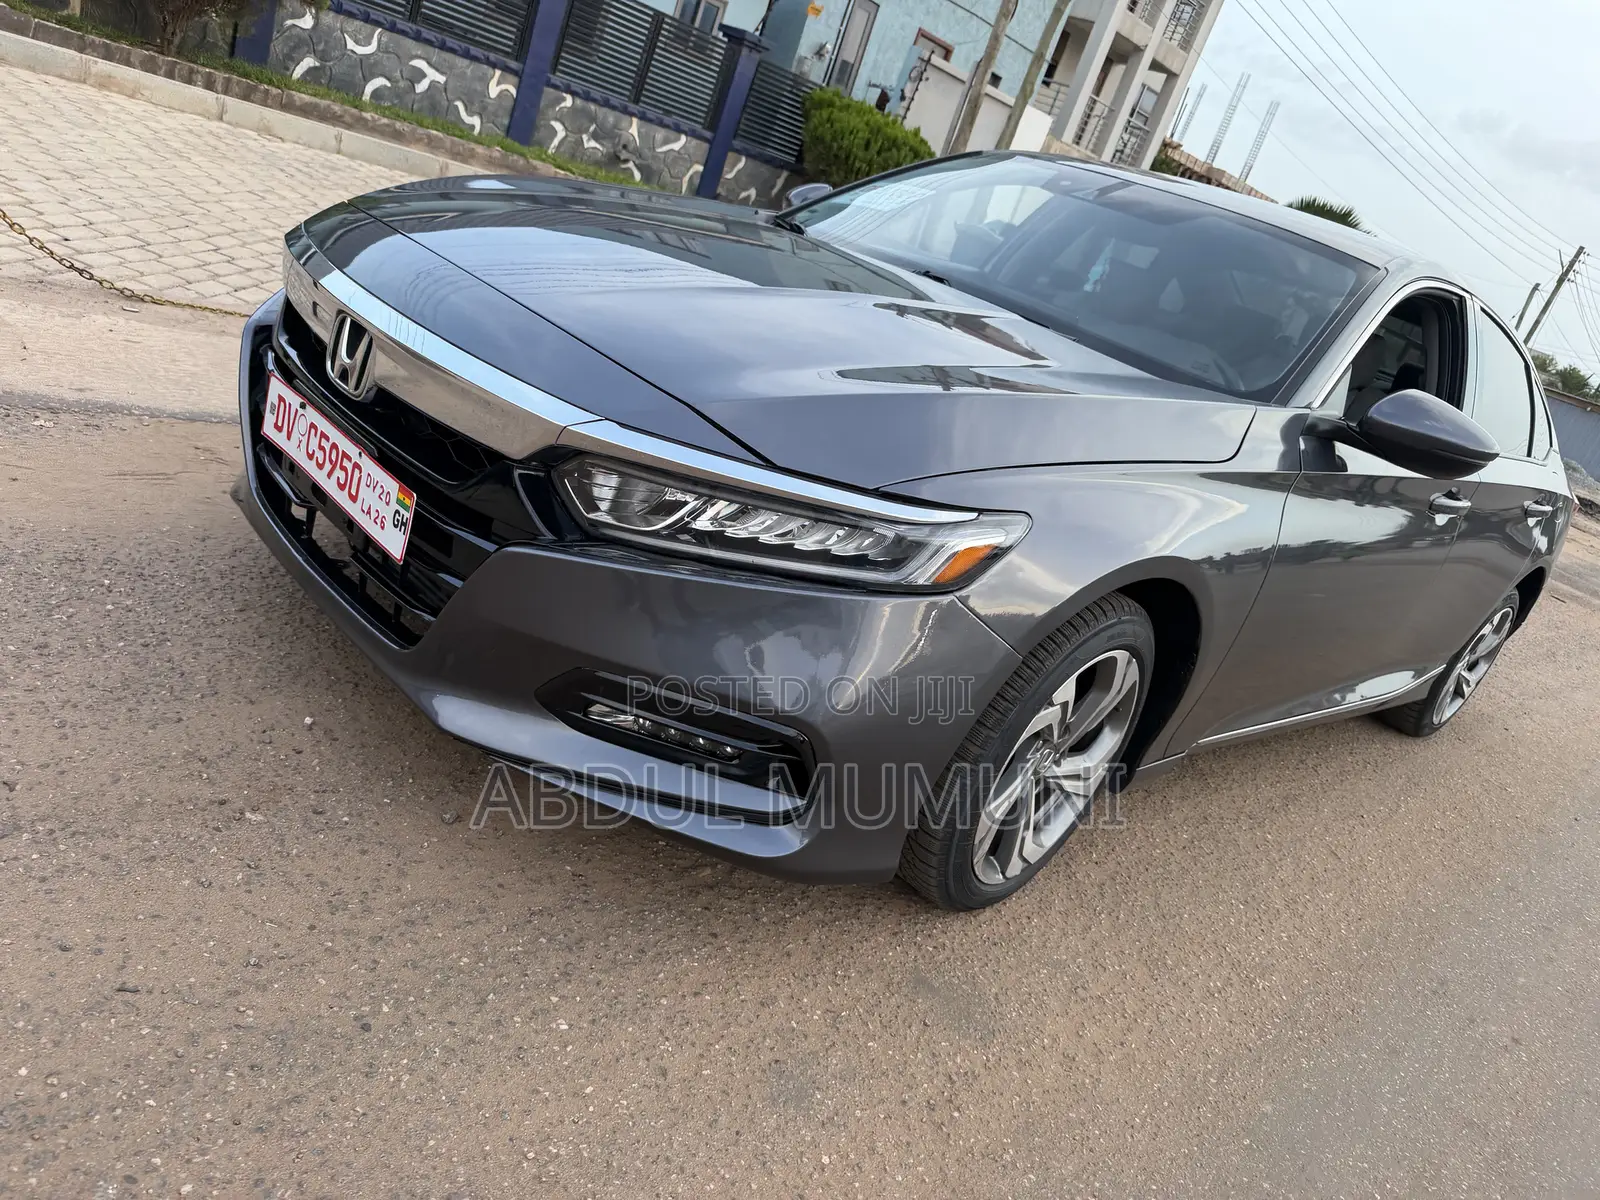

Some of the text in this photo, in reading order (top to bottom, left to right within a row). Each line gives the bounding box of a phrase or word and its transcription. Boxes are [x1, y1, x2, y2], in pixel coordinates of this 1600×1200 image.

[274, 393, 363, 504] DV C5950
[392, 509, 409, 536] GH
